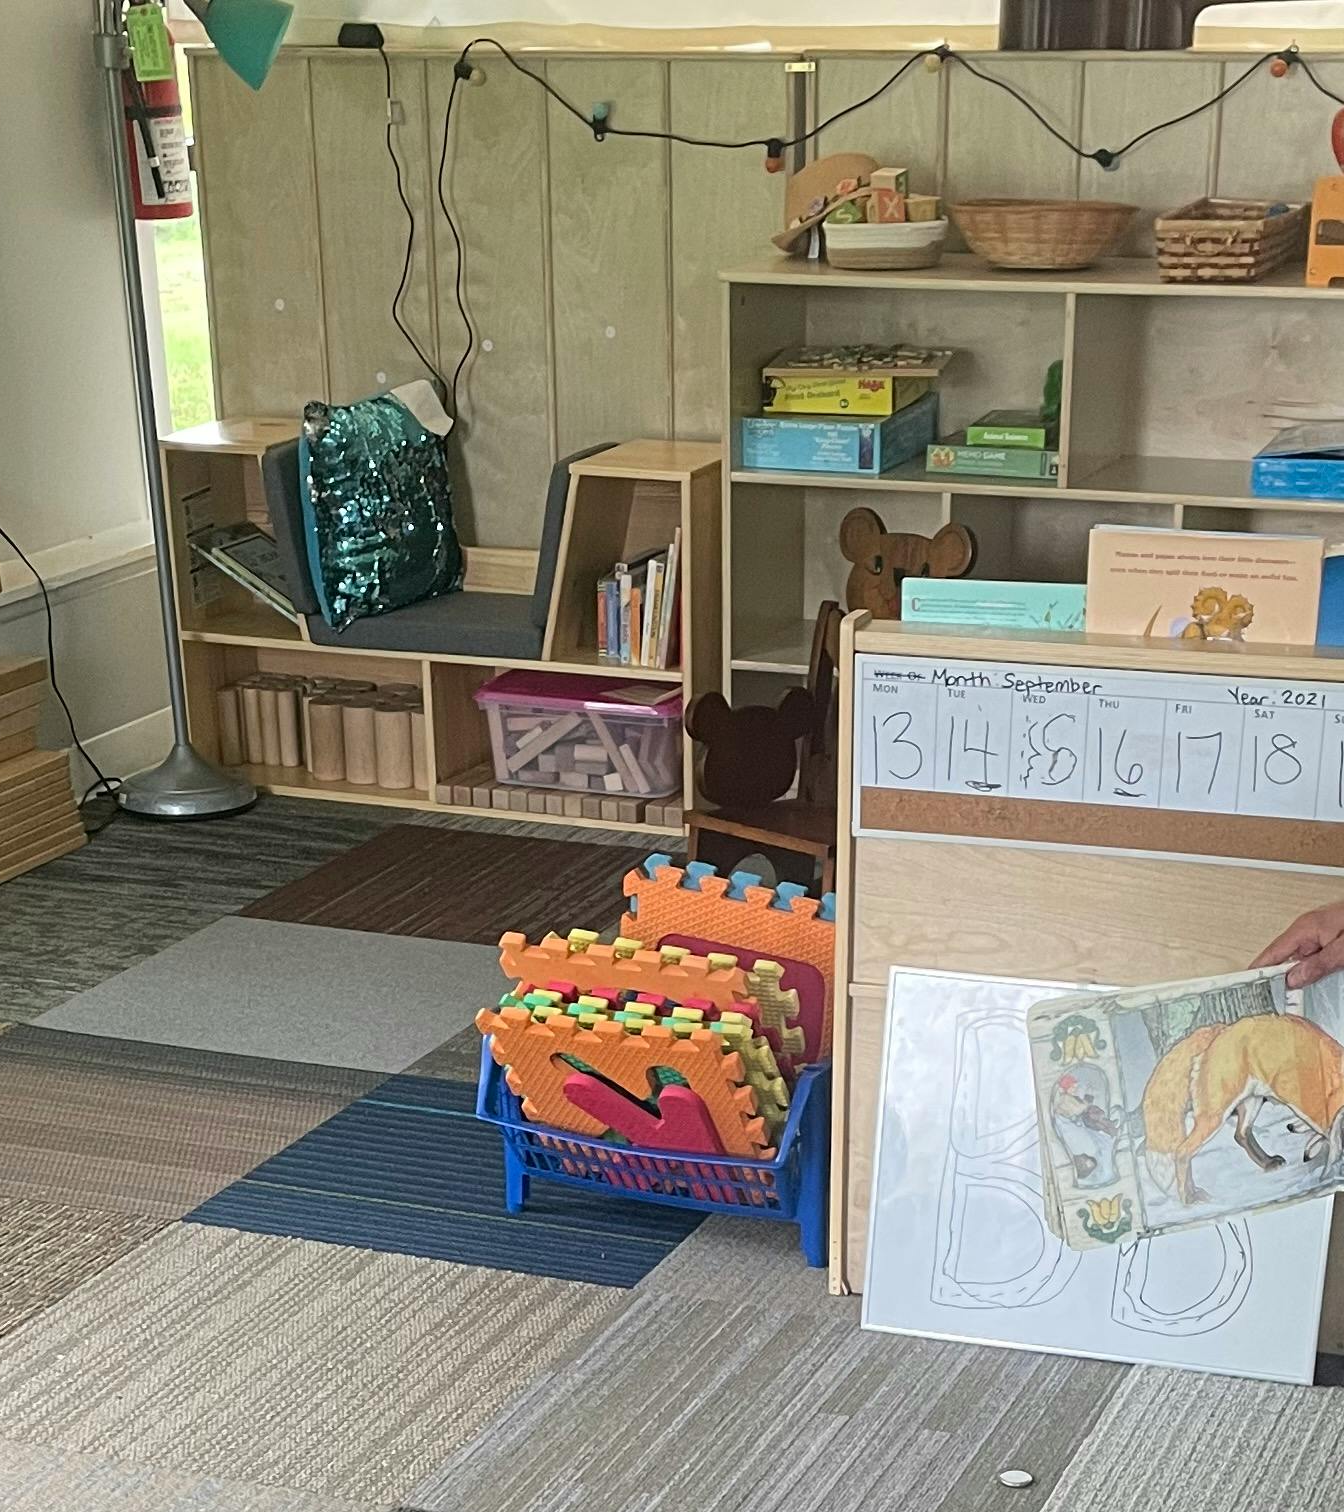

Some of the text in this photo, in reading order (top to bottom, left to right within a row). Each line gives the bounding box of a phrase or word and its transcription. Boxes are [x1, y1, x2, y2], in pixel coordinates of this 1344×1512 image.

[872, 683, 899, 695] MON
[947, 688, 968, 700] TUE
[1022, 693, 1047, 705] WED
[1098, 698, 1121, 710] THU
[1175, 703, 1193, 715] FRI
[1254, 708, 1276, 720] SAT
[1002, 672, 1104, 696] September
[1281, 689, 1327, 708] 2021
[872, 711, 923, 785] 13
[947, 715, 999, 786] 14
[1097, 726, 1144, 791] 16
[1175, 731, 1223, 795] 17
[1252, 733, 1303, 793] 18
